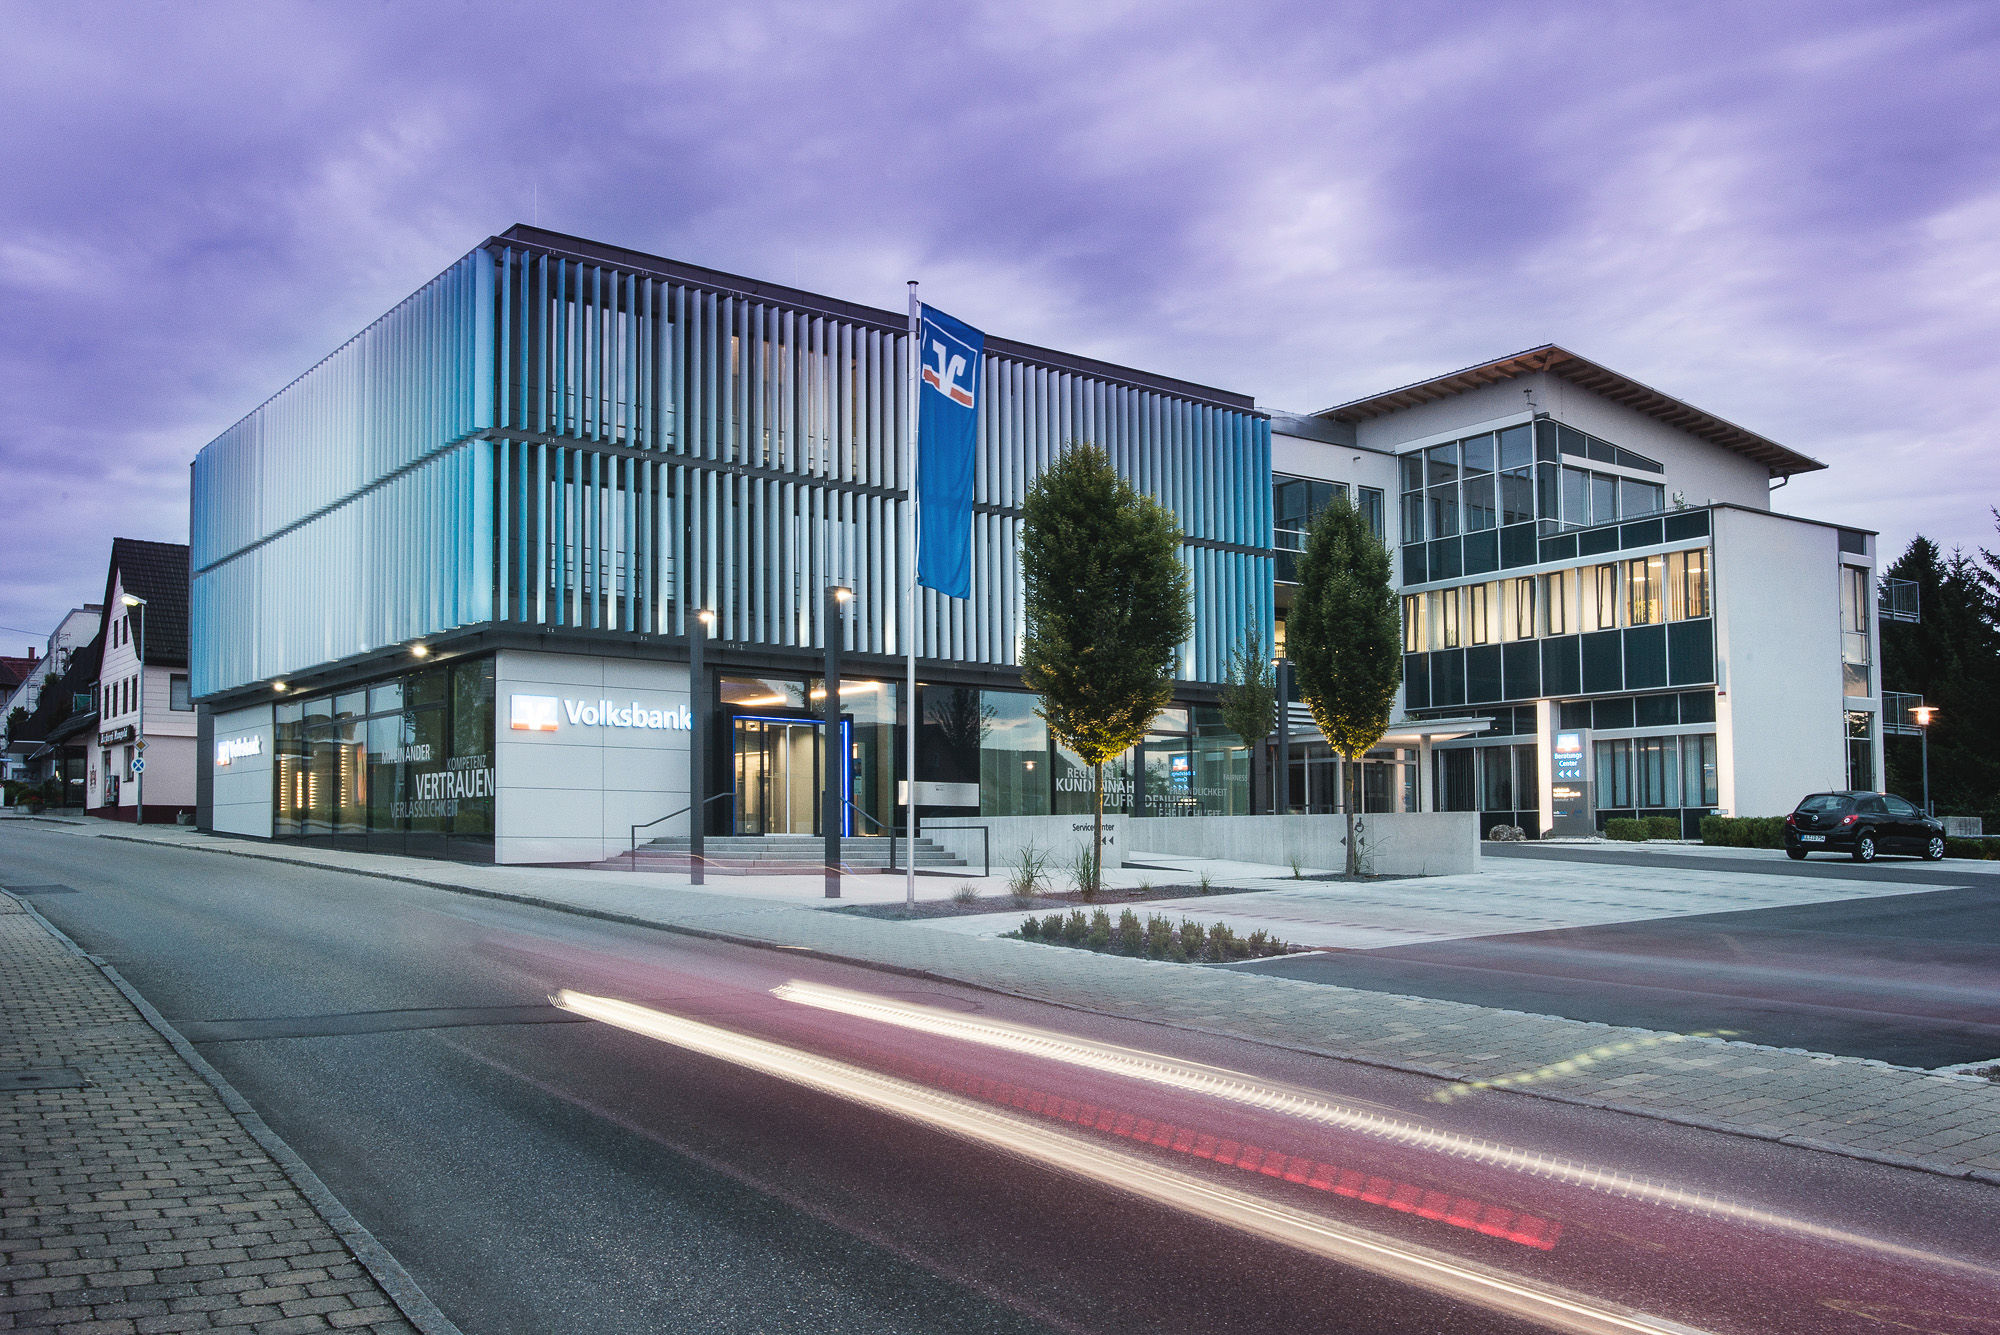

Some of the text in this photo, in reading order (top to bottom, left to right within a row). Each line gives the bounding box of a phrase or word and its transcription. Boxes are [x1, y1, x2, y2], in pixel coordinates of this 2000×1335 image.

[563, 699, 691, 730] Volksbank
[447, 755, 487, 771] KOMPETENZ
[416, 767, 495, 800] VERTRAUEN
[1223, 773, 1249, 782] FAIRNESS
[389, 797, 460, 819] VERLÄSSLICHKEIT
[1072, 823, 1115, 832] Servicenter
